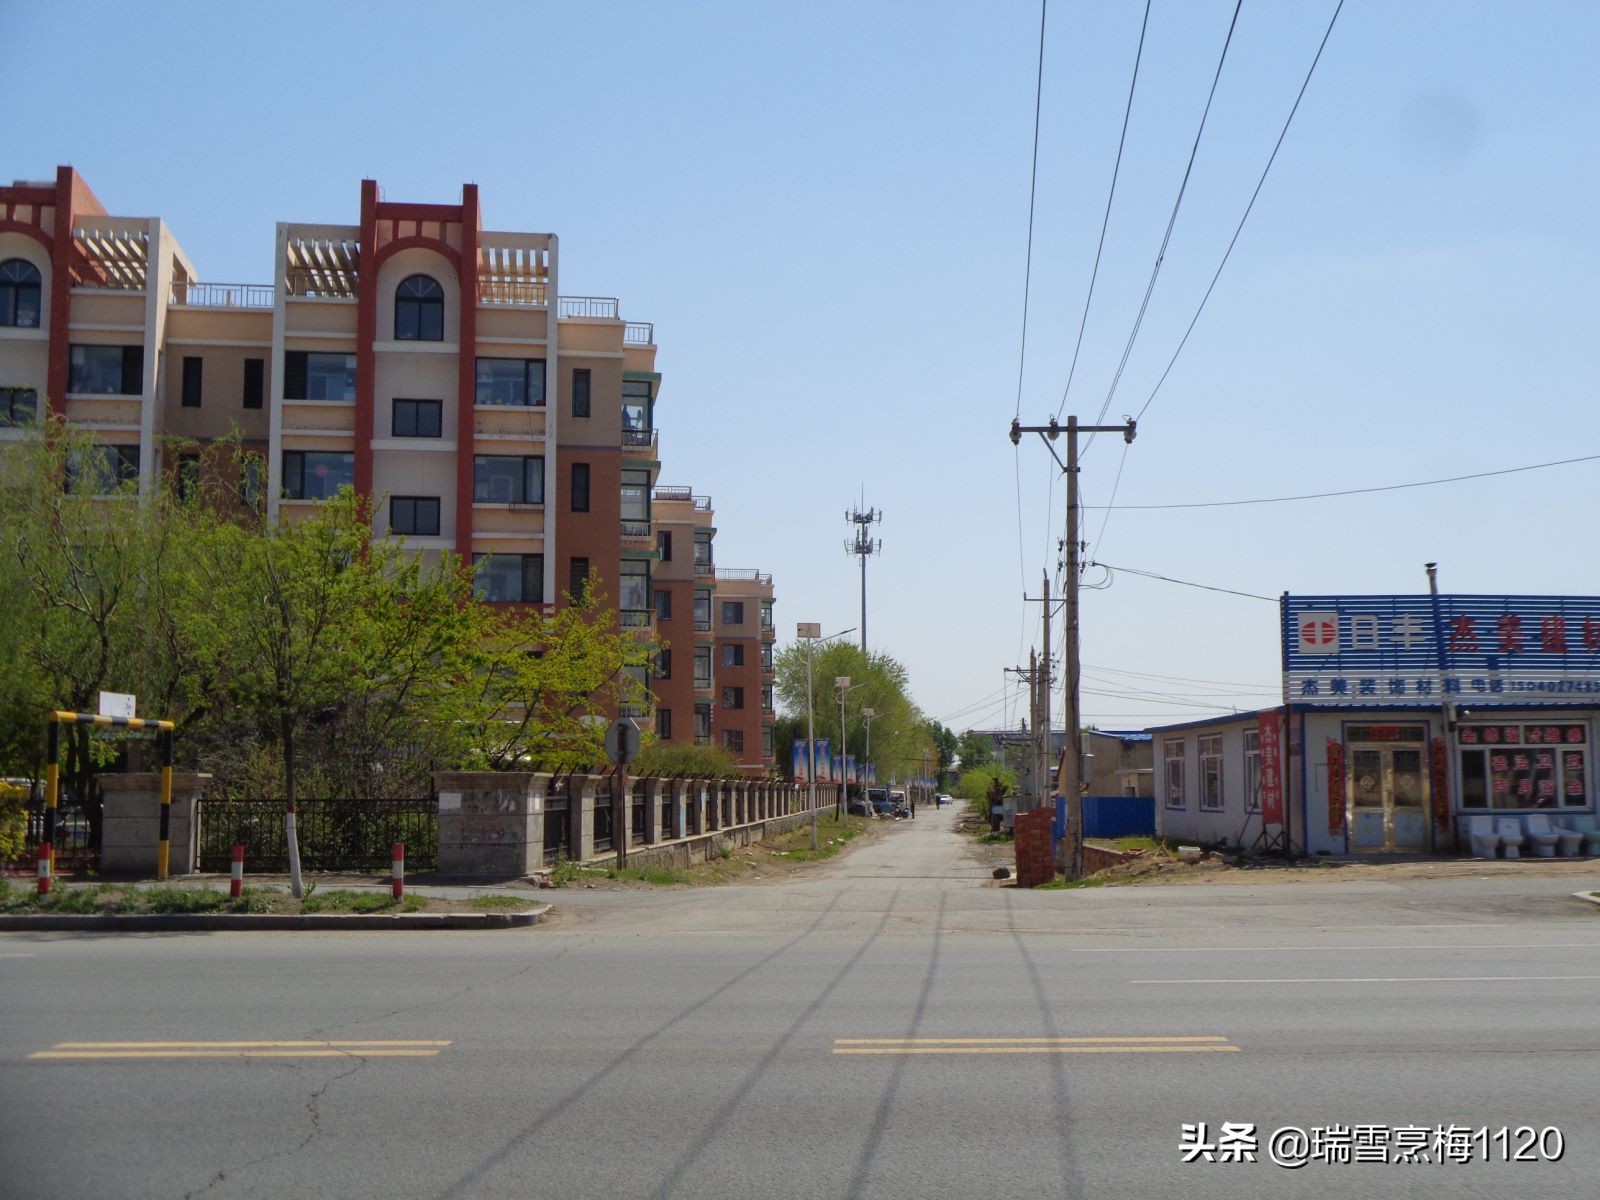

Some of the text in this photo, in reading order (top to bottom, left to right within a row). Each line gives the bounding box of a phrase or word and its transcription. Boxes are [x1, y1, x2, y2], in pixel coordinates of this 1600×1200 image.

[1351, 613, 1426, 650] 日丰
[1301, 677, 1461, 695] 杰美装饰材料
